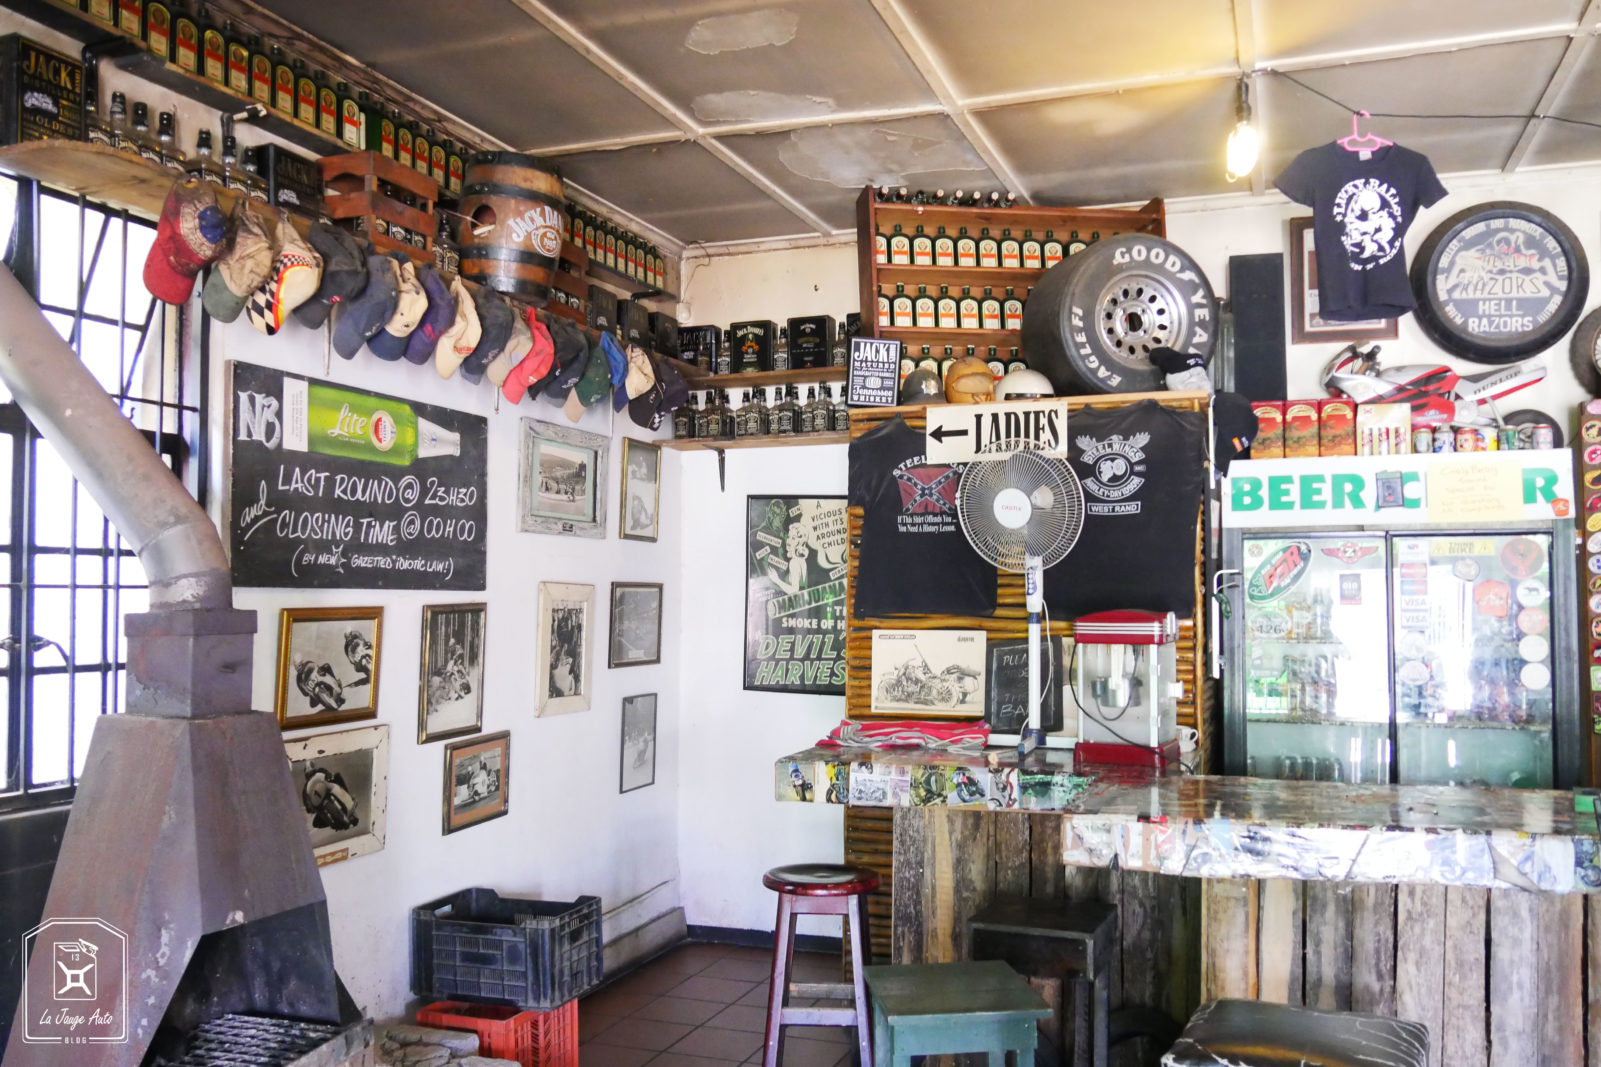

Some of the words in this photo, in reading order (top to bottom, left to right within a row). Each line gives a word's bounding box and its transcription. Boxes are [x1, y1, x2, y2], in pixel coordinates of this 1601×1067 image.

[23, 50, 73, 90] JACK
[507, 207, 545, 242] JACK
[1478, 300, 1523, 315] HELL
[1468, 316, 1533, 333] RAZORS
[854, 342, 889, 362] JACK
[1075, 331, 1122, 387] EAGLE
[854, 361, 895, 369] MATURED
[852, 395, 893, 403] WHISKEY
[853, 385, 893, 396] Tennessee
[237, 390, 281, 450] NB
[327, 403, 368, 437] Lite
[974, 409, 1060, 454] LADIES
[1084, 443, 1112, 463] STEEL
[1112, 442, 1142, 463] WINGS
[893, 455, 927, 477] STEEL
[278, 464, 330, 497] LAST
[334, 474, 396, 504] ROUND
[397, 475, 420, 507] @
[424, 477, 477, 506] 23H30
[1231, 473, 1367, 511] BEER
[241, 480, 275, 527] and
[816, 500, 822, 510] A
[1091, 505, 1113, 513] WEST
[1114, 504, 1137, 512] RAND
[811, 507, 843, 522] VICIOUS
[903, 515, 912, 523] This
[913, 515, 924, 523] Shirt
[924, 514, 942, 523] Offends
[400, 511, 420, 541] @
[812, 520, 830, 532] WITH
[832, 517, 844, 526] IT'S
[907, 524, 919, 532] Need
[923, 524, 939, 534] History
[816, 527, 847, 541] AROUND
[317, 553, 339, 565] NEW
[777, 580, 847, 615] MARIJUANA
[782, 618, 818, 628] SMOKE
[820, 619, 834, 630] OF
